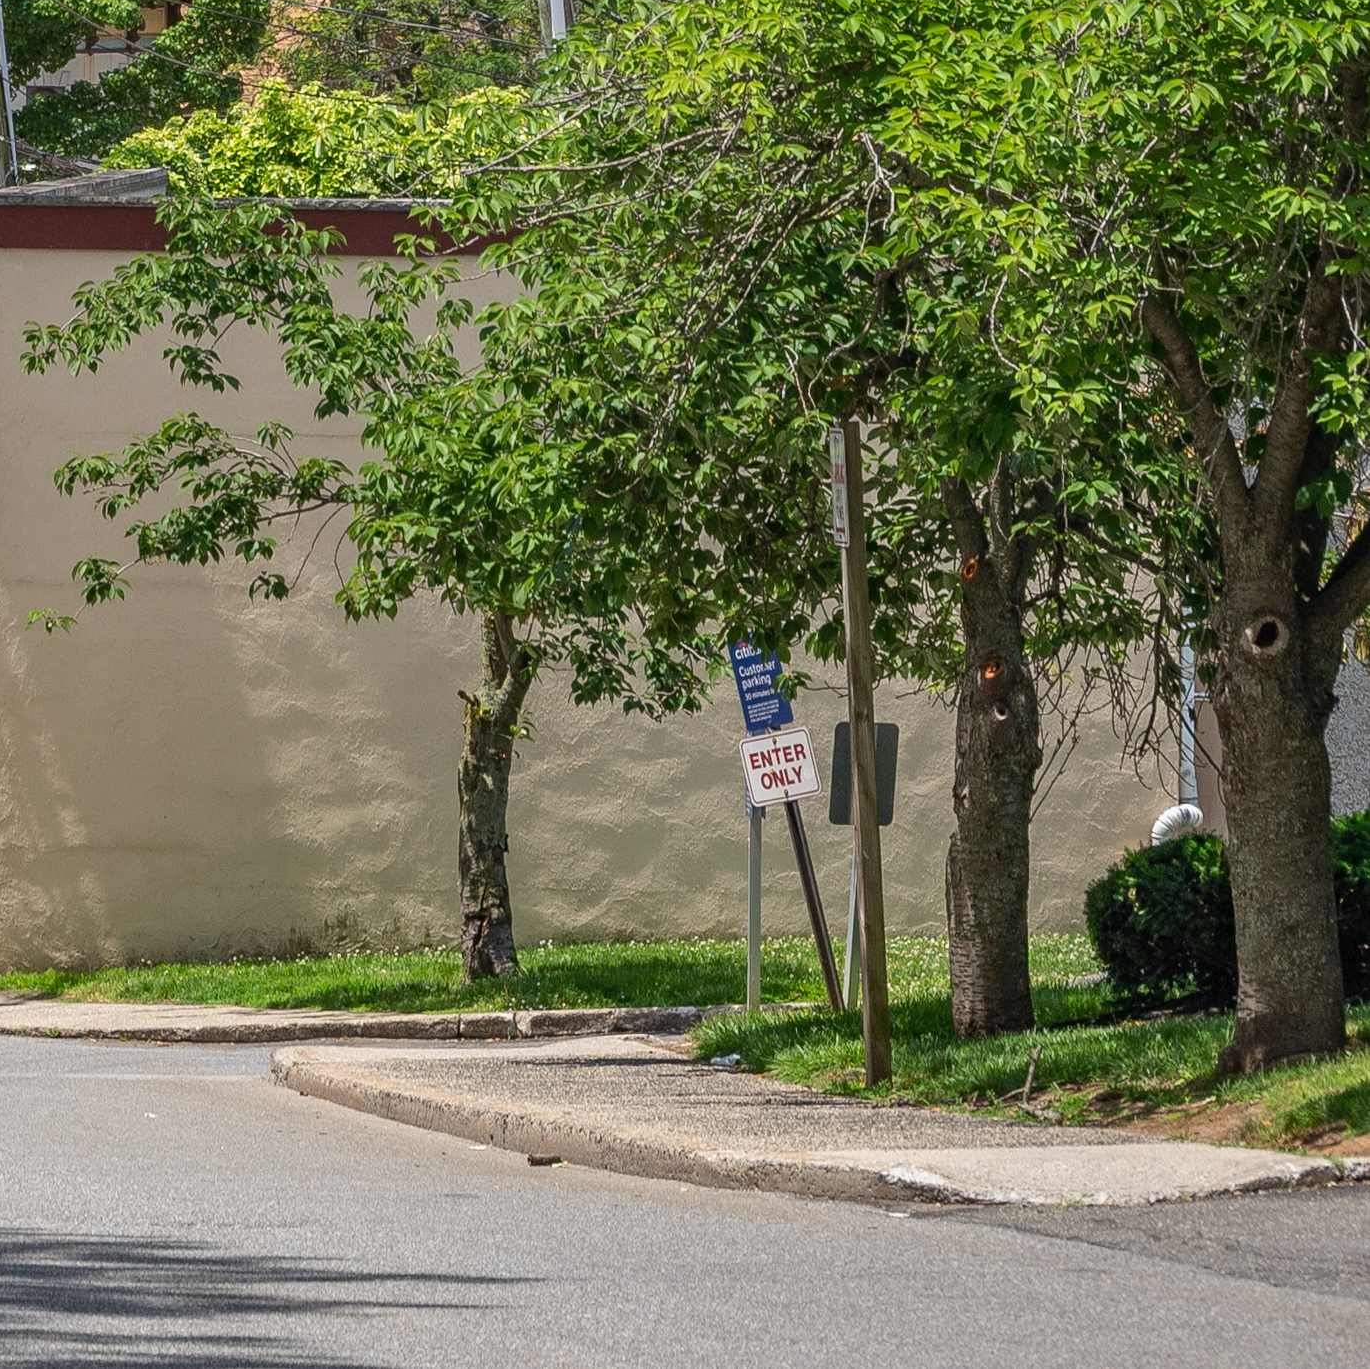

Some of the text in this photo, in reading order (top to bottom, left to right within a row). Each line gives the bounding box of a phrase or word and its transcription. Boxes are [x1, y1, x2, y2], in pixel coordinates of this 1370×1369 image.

[741, 674, 772, 692] parking
[749, 743, 807, 770] ENTER
[760, 765, 803, 790] ONLY
